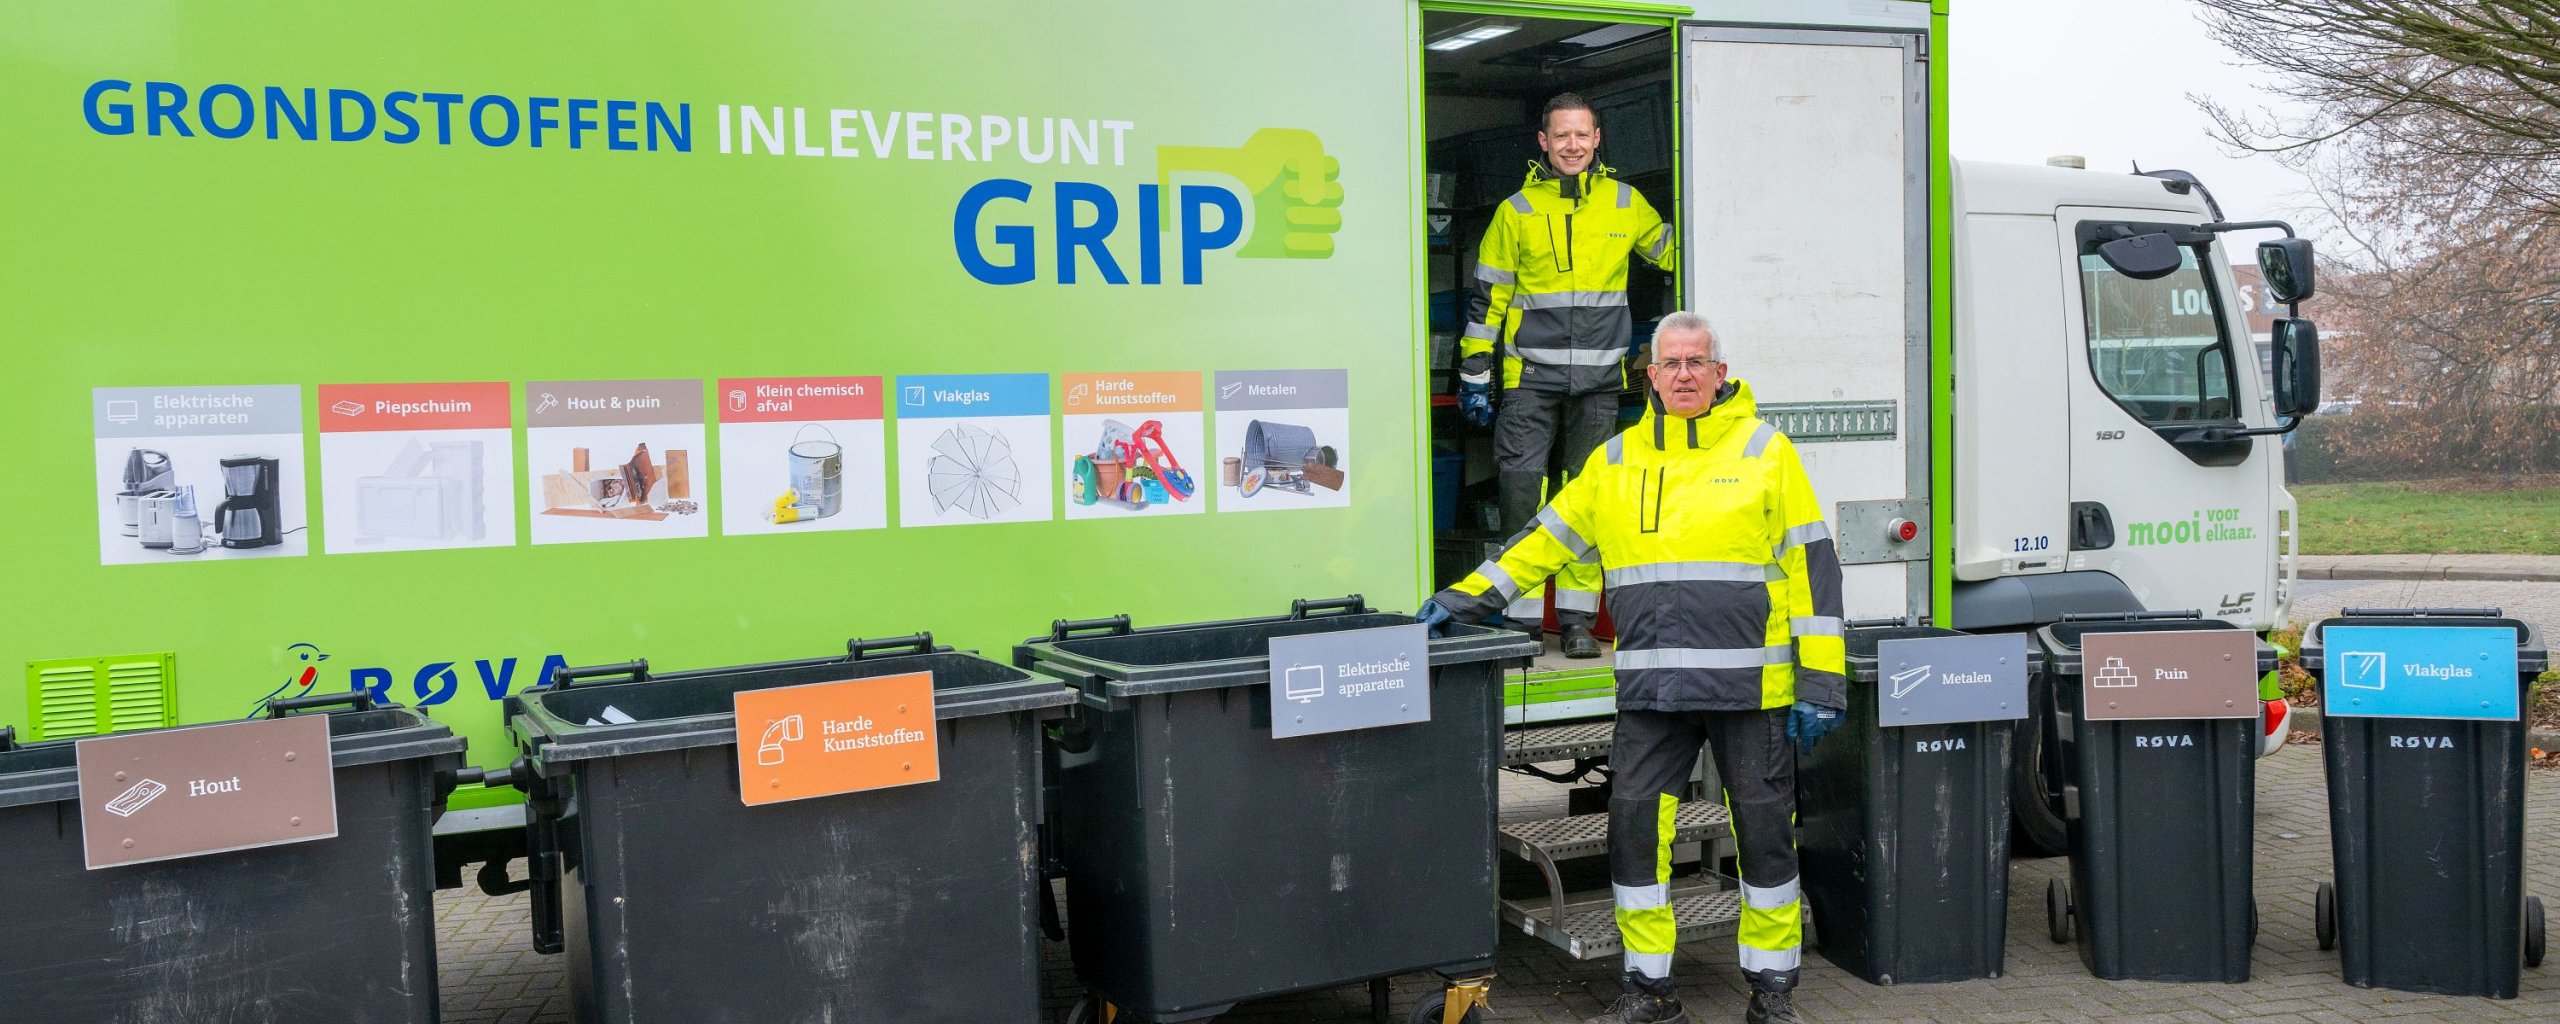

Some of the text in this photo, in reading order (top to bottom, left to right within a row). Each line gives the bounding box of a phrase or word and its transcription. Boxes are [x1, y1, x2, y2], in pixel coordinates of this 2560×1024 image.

[83, 79, 1134, 166] GRONDSTOFFEN INLEVERPUNT
[953, 178, 1244, 286] GRIP
[756, 383, 864, 398] Klein chemisch
[1096, 379, 1134, 391] Harde
[1249, 383, 1297, 396] Metalen
[153, 394, 254, 409] Elektrische
[567, 395, 661, 413] Hout & puin
[933, 389, 990, 405] Vlakglas
[1096, 392, 1176, 405] kunststoffen
[375, 399, 472, 417] Piepschuim
[757, 399, 792, 412] afval
[154, 412, 249, 428] apparaten
[2096, 430, 2125, 440] 180
[2206, 508, 2239, 521] voor
[2128, 510, 2201, 546] mooi
[2206, 524, 2256, 541] elkaar.
[2014, 535, 2048, 552] 12.10
[2220, 591, 2256, 607] LF
[2216, 607, 2243, 616] EURO
[1338, 658, 1410, 677] Elektrische
[2155, 667, 2188, 681] Puin
[2403, 663, 2473, 680] Vlakglas
[1942, 671, 1992, 685] Metalen
[1339, 677, 1405, 698] apparaten
[822, 715, 873, 736] Harde
[823, 728, 925, 753] Kunststoffen
[188, 776, 242, 797] Hout
